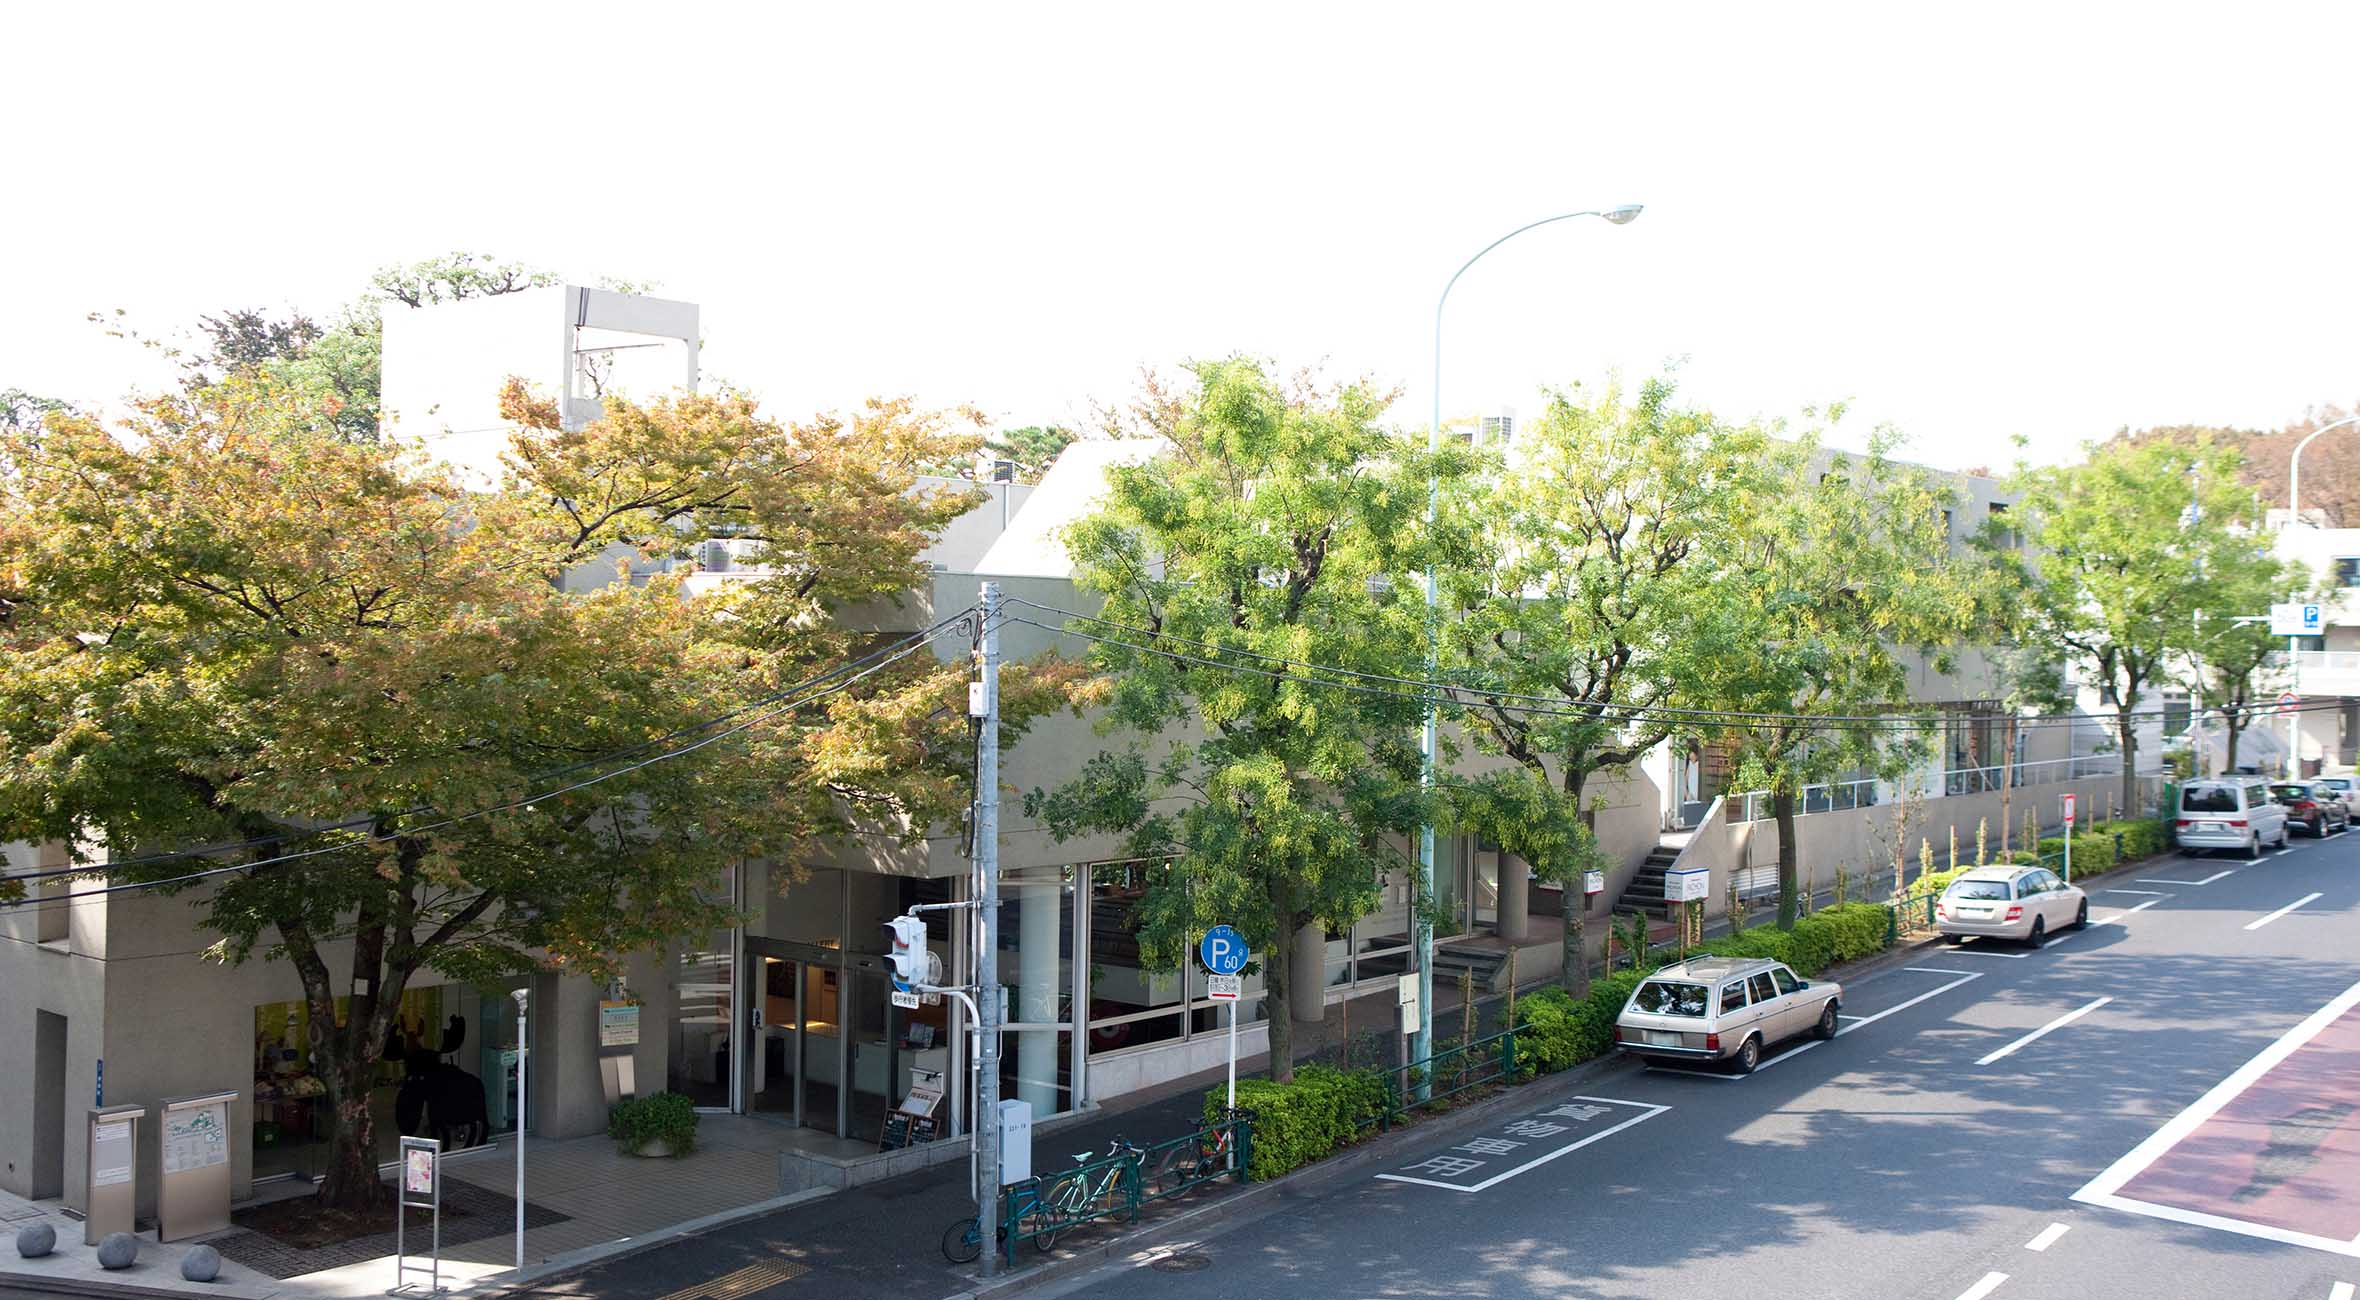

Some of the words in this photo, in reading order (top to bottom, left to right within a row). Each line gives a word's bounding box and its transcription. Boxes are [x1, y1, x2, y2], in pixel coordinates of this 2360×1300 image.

[2306, 607, 2317, 621] P
[1212, 938, 1230, 968] P
[1224, 955, 1238, 969] 60
